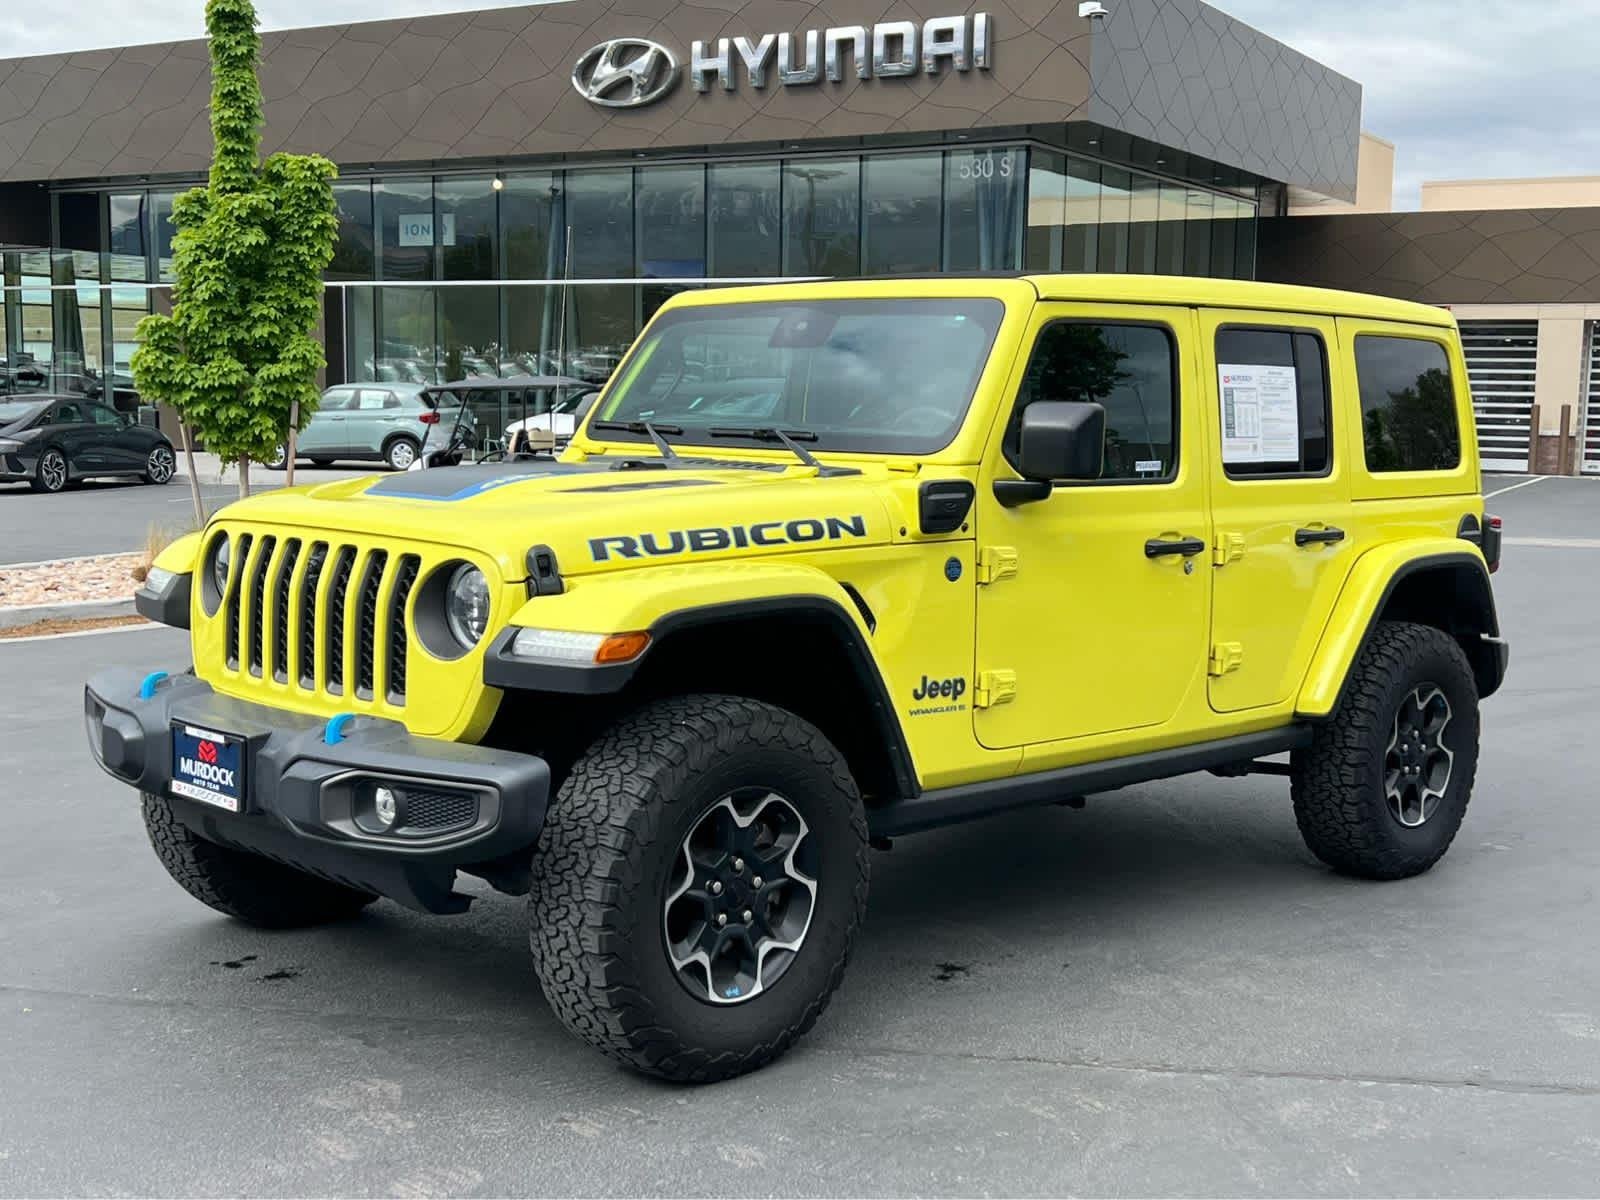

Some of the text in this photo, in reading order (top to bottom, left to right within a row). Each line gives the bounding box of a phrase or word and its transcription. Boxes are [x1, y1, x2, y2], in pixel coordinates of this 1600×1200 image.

[691, 12, 992, 92] HYUNDAI
[588, 515, 867, 562] RUBICON
[913, 675, 965, 701] Jeep
[181, 757, 234, 787] MURDOCK
